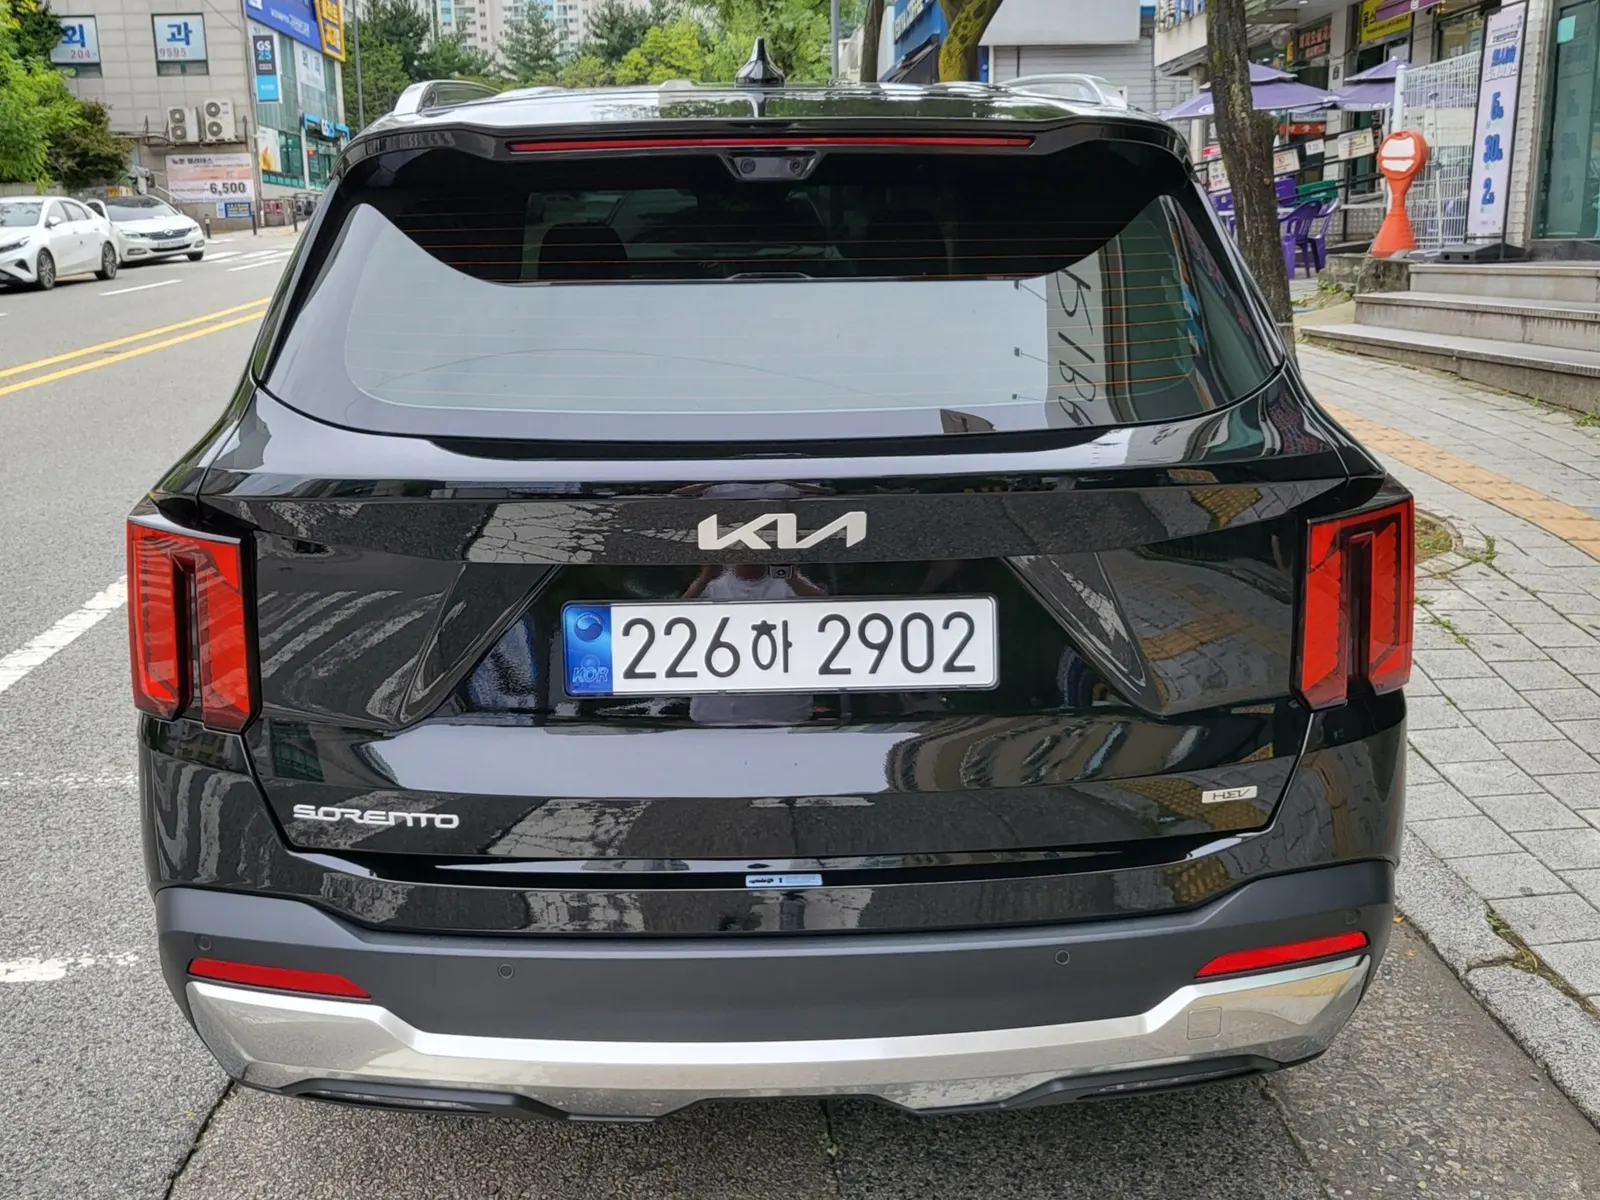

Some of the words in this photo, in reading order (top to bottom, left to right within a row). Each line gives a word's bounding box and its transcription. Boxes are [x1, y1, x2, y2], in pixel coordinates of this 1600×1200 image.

[62, 24, 86, 48] 외
[167, 22, 193, 46] 과
[256, 40, 271, 51] GS
[209, 182, 246, 196] 6,500
[697, 511, 867, 550] KIA
[622, 616, 792, 679] 226하
[817, 611, 976, 675] 2902
[572, 666, 609, 683] KOR
[1212, 788, 1251, 800] HEV
[293, 804, 460, 829] SORENTO
